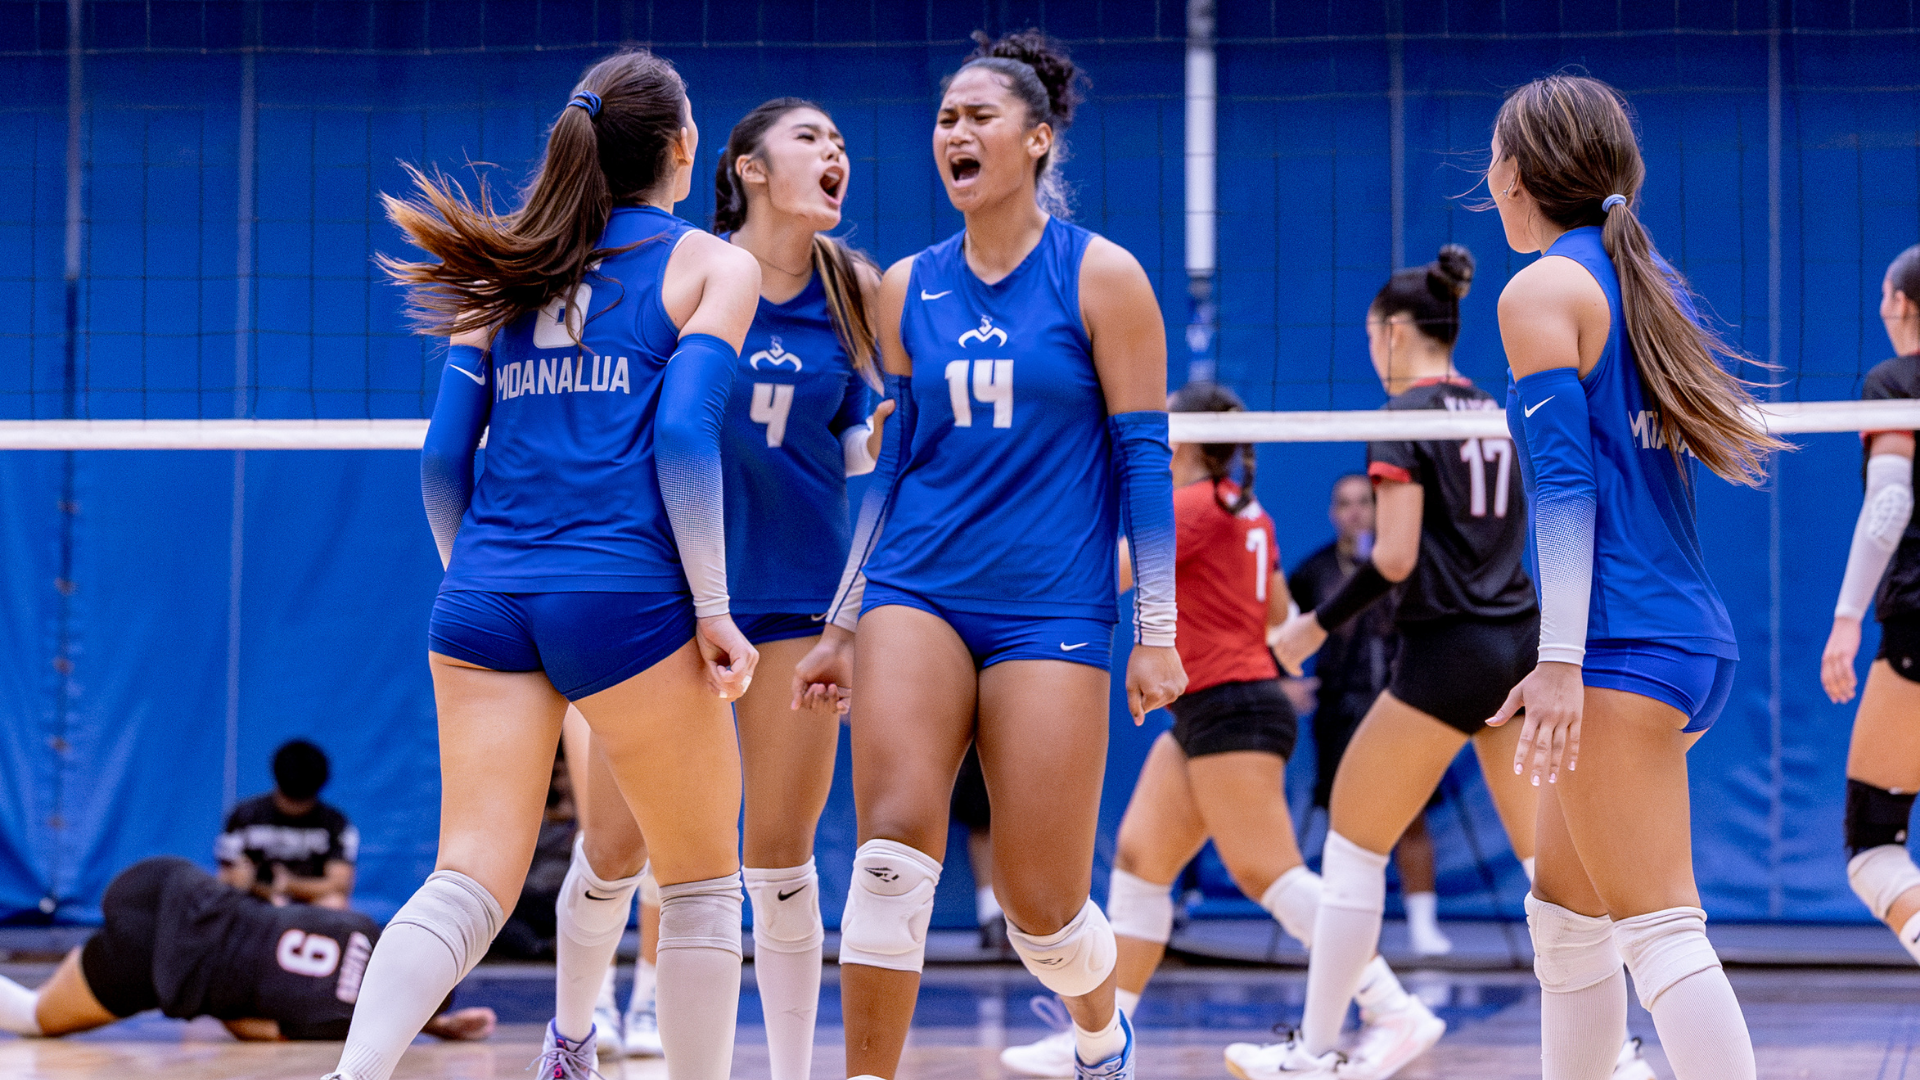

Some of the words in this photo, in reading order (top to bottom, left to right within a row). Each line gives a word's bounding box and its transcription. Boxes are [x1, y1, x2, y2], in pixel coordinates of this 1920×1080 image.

[496, 355, 631, 404] MOANALUA
[944, 359, 1014, 428] 14
[749, 382, 795, 448] 4
[1460, 438, 1511, 518] 17
